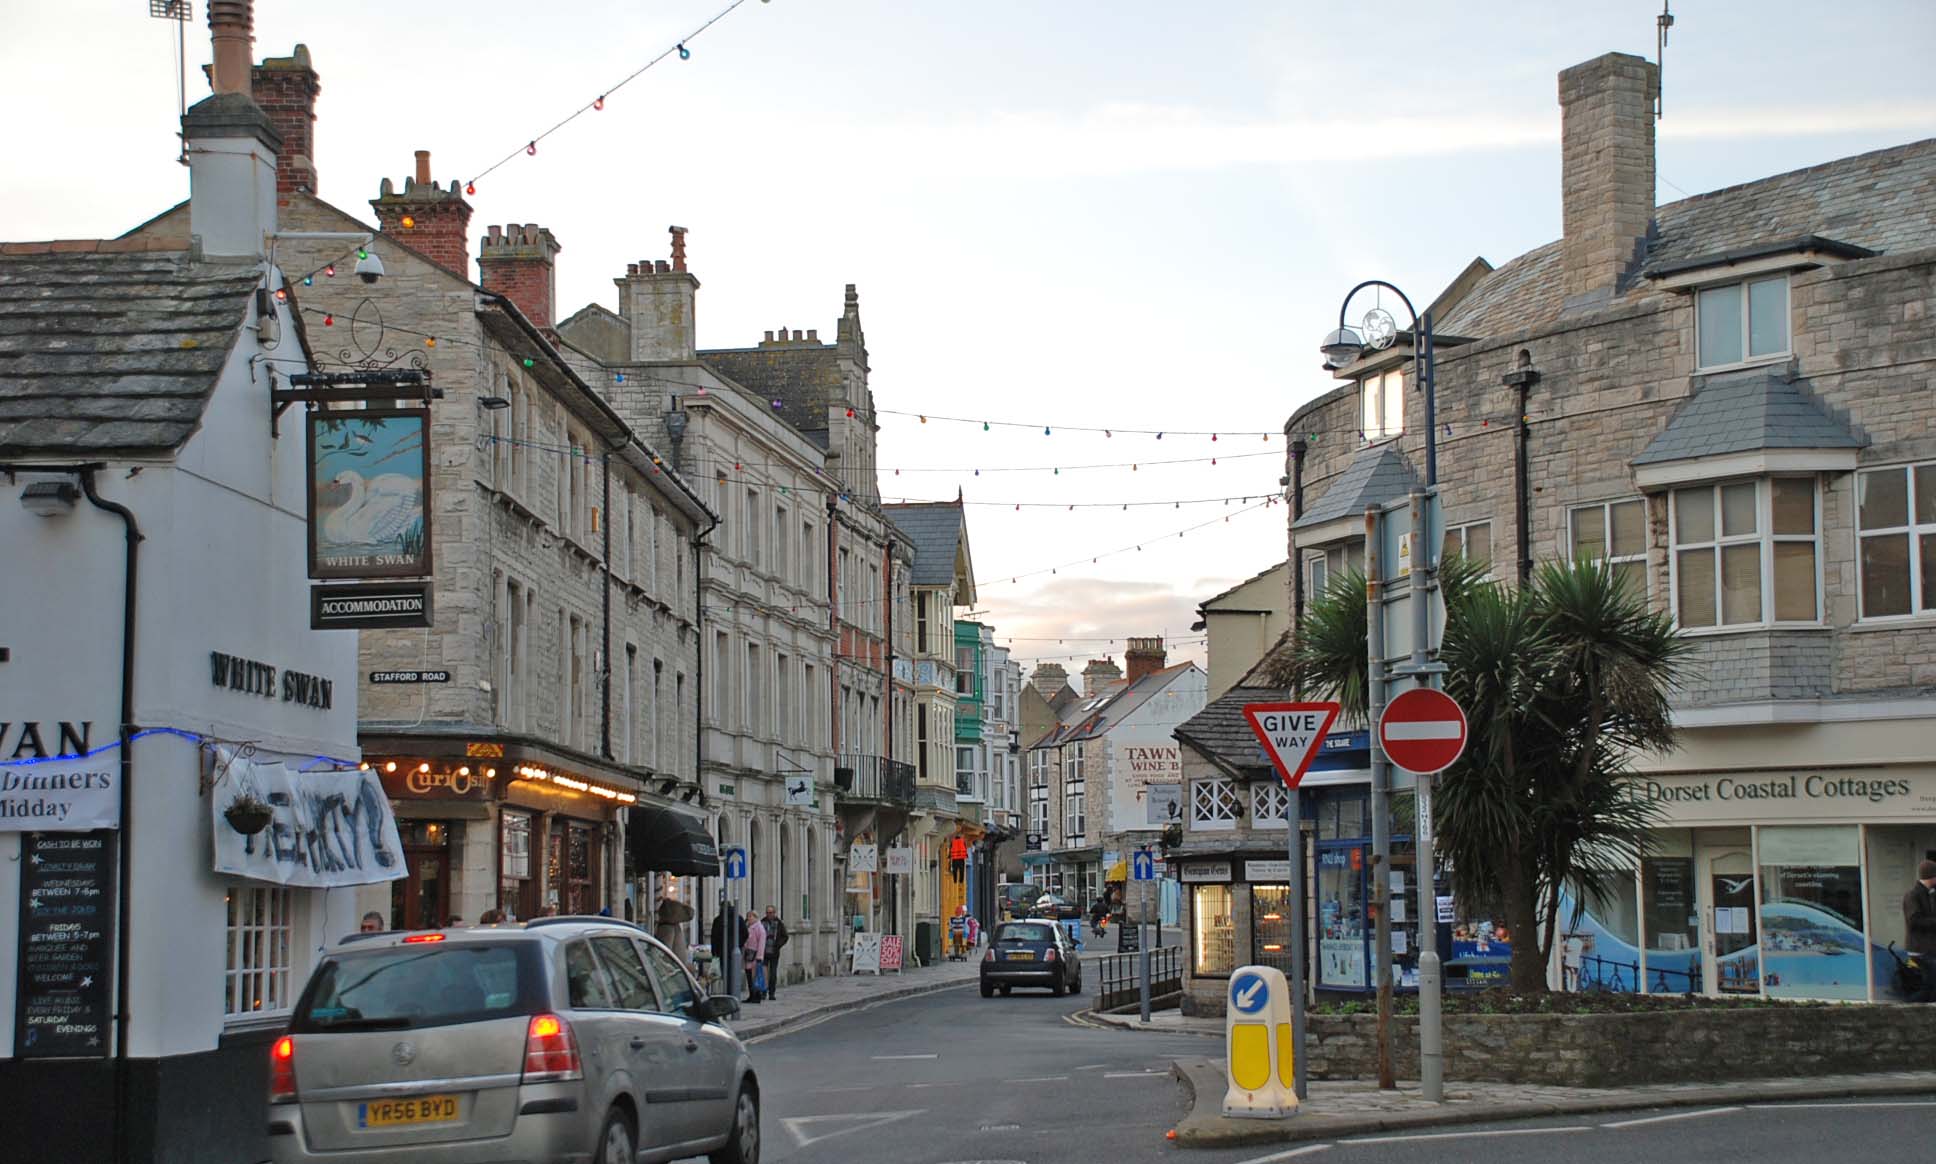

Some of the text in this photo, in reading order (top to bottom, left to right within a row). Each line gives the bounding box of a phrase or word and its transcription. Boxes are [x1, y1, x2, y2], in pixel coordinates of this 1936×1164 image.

[325, 554, 415, 567] WHITE SWAN
[321, 598, 423, 614] ACCOMMODATION
[210, 650, 333, 711] WHITE SWAN
[373, 672, 446, 682] STAFFORD ROAD
[1263, 714, 1317, 748] GIVE WAY
[1131, 761, 1166, 771] WINE
[2, 770, 112, 792] Dinners
[1646, 774, 1910, 802] Dorset Coastal Cottages
[32, 888, 71, 896] BETWEEN
[50, 923, 81, 932] FRIDAYS
[31, 932, 70, 942] BETWEEN
[881, 936, 902, 947] SALE
[881, 947, 902, 959] 50%
[28, 1015, 70, 1024] SATURDAY
[56, 1024, 97, 1033] EVENINGS
[369, 1098, 455, 1121] YR56 BYD
